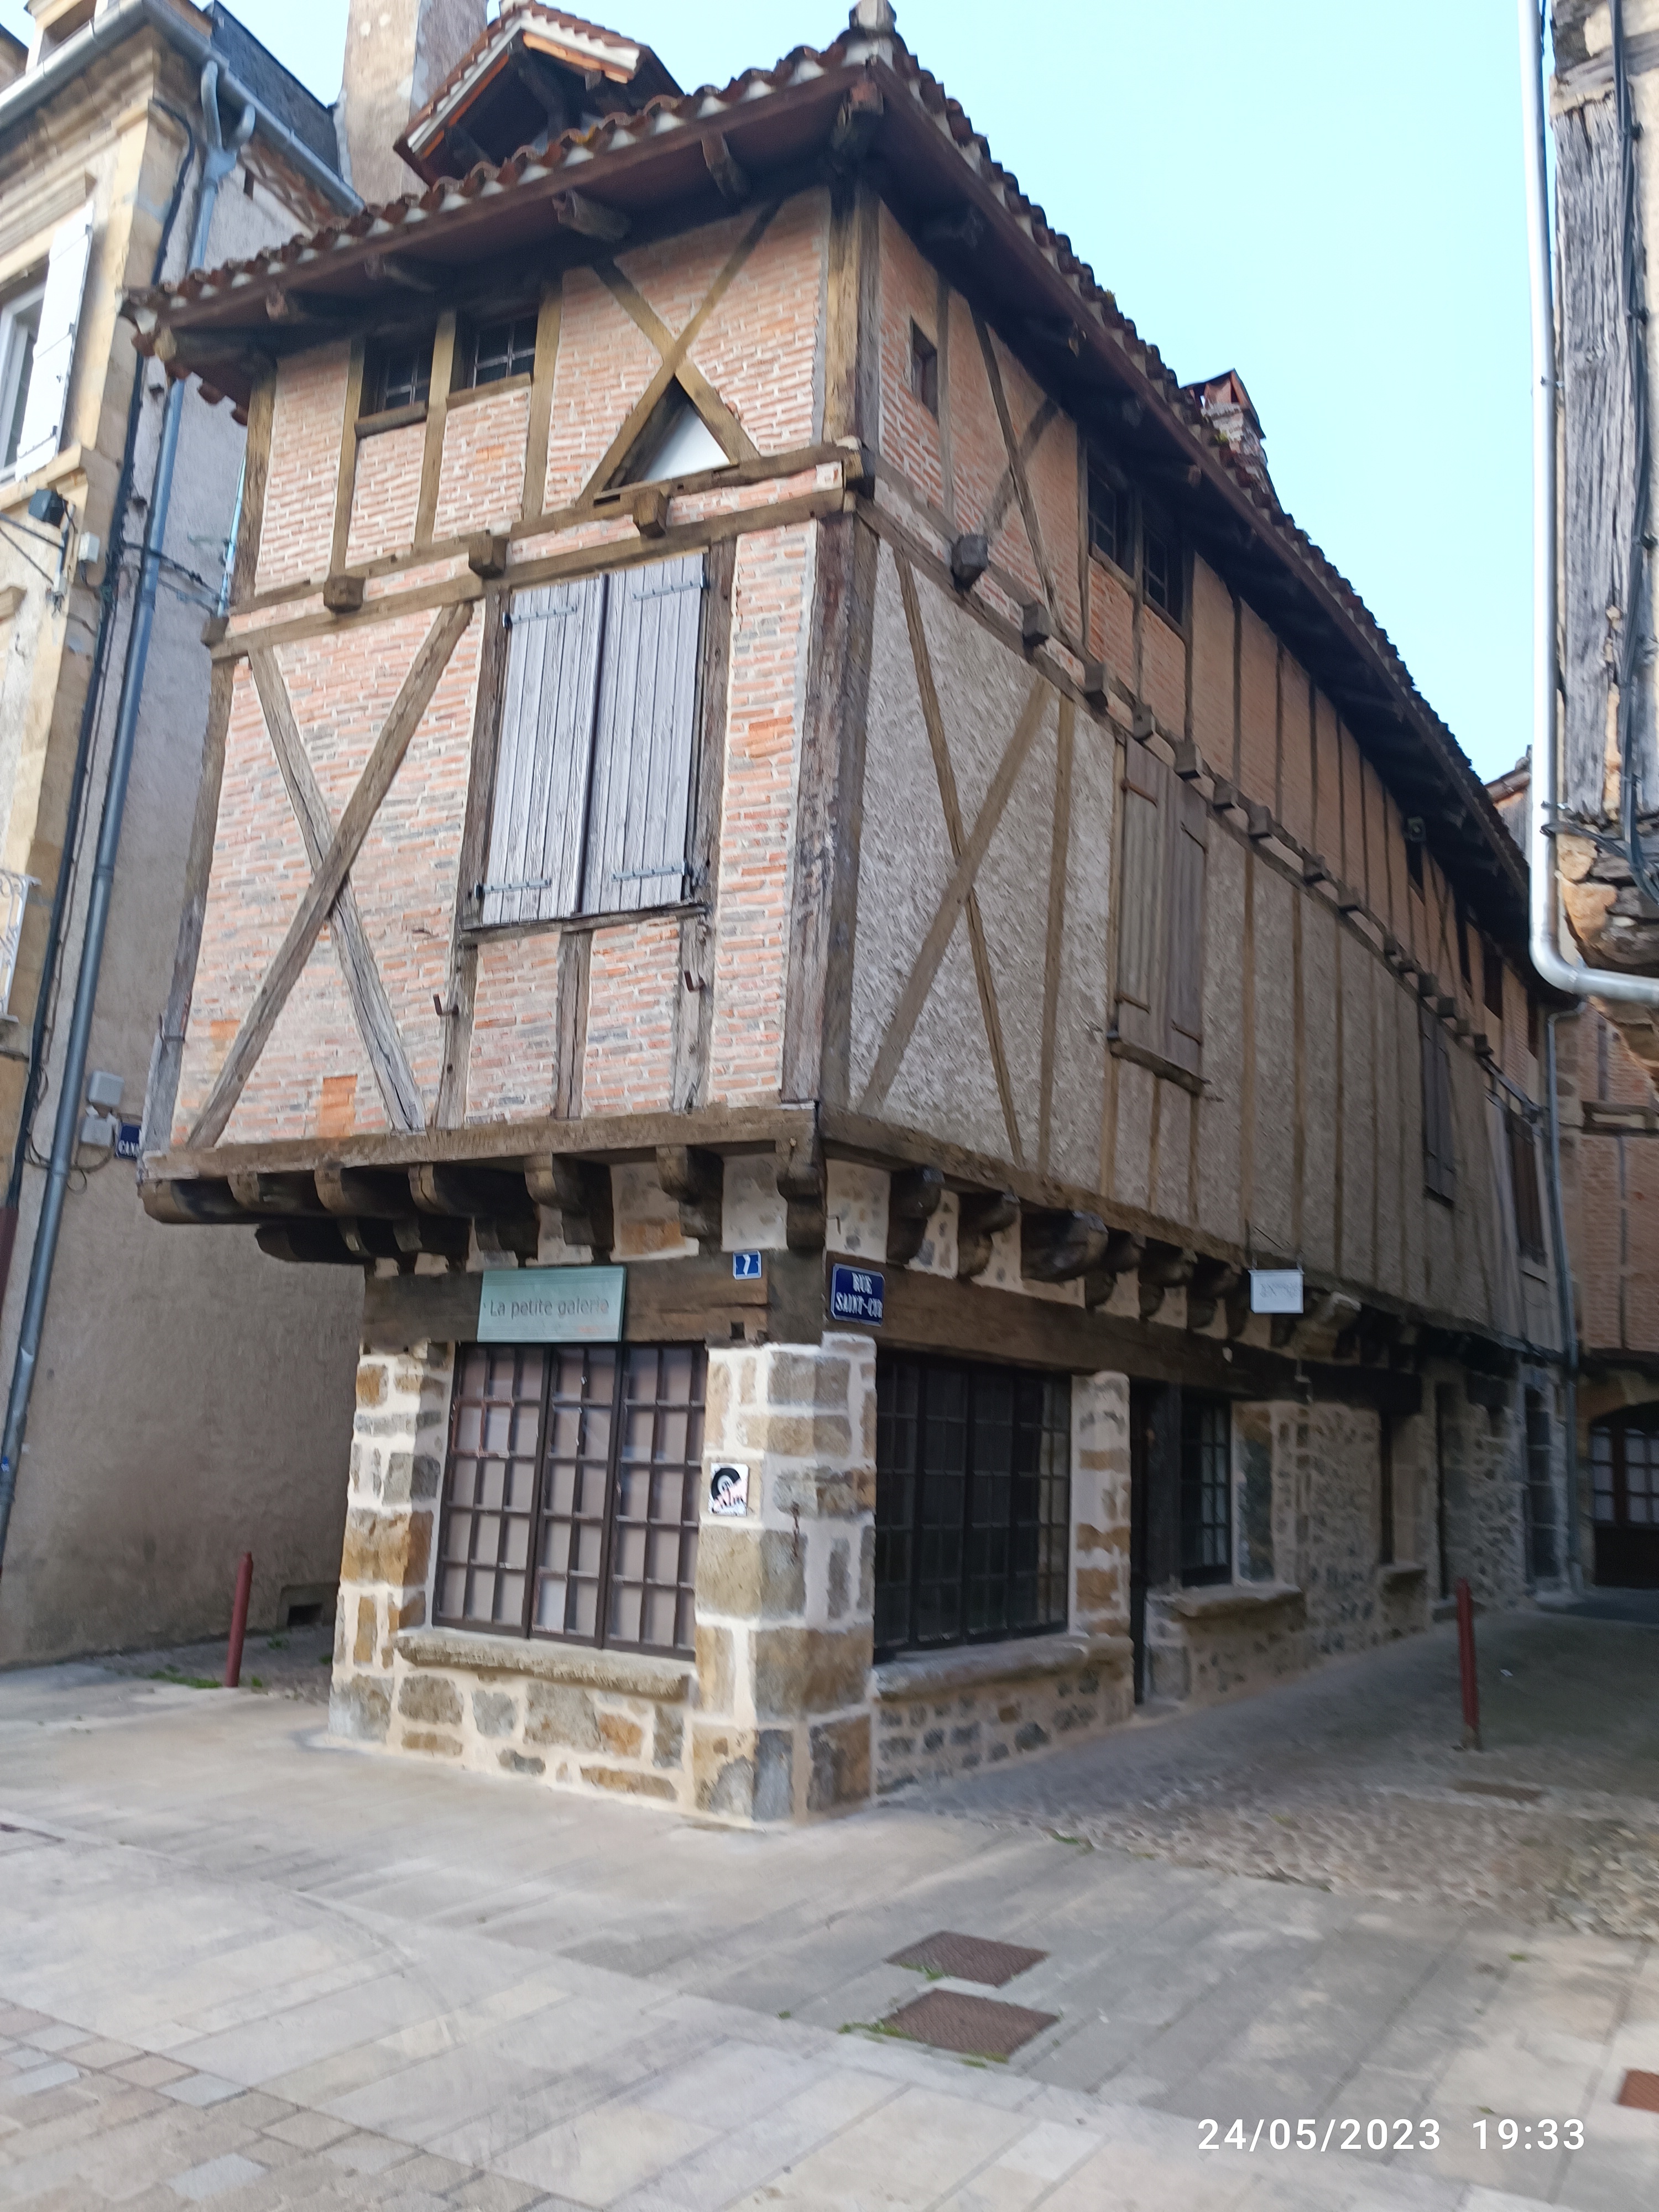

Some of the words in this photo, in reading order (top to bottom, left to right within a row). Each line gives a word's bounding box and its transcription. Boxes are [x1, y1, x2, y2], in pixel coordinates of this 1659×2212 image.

[742, 1254, 750, 1276] 7
[851, 1272, 873, 1295] RUE
[490, 1299, 505, 1317] La
[511, 1297, 552, 1320] petite
[557, 1296, 609, 1319] galerie
